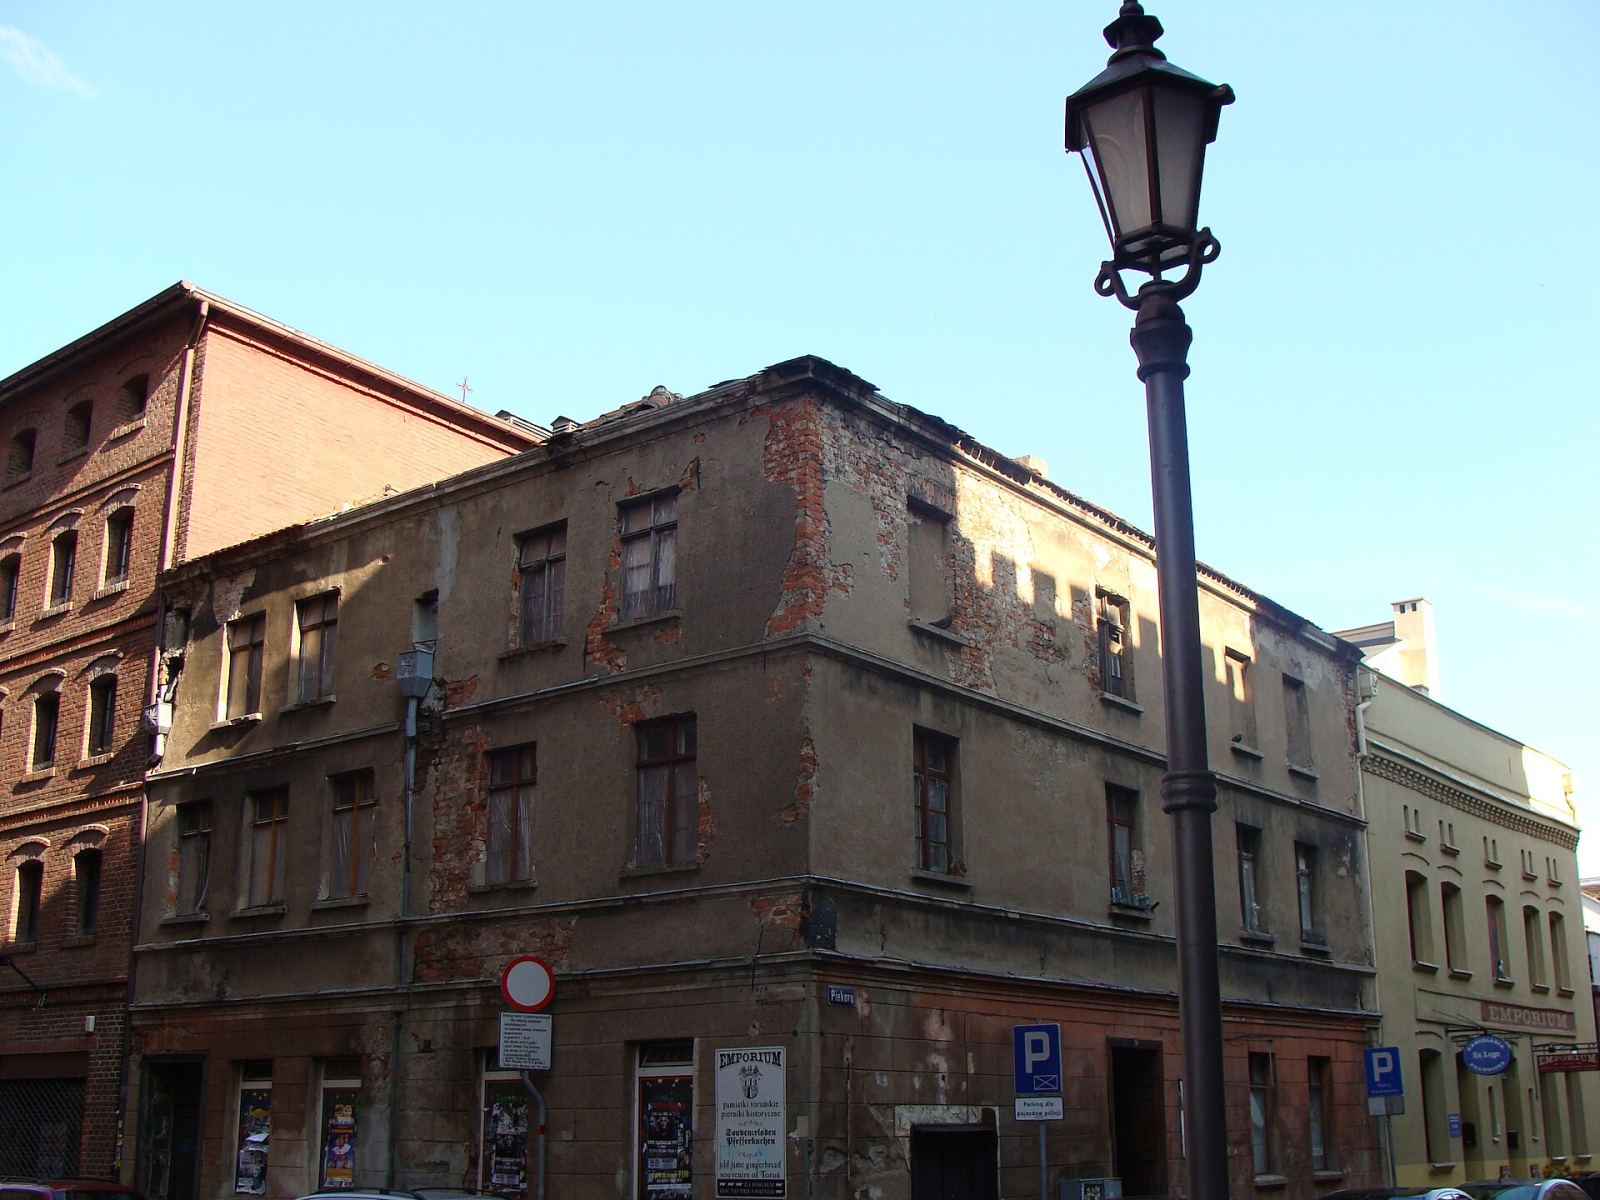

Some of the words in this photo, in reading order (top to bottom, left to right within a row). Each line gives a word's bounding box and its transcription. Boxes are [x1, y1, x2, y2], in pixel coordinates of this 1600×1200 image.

[1488, 1006, 1567, 1028] EMPORIUM
[719, 1052, 782, 1069] EMPORIUM
[1025, 1032, 1050, 1073] P
[1539, 1055, 1597, 1066] EMPORIUM
[1372, 1052, 1393, 1082] P
